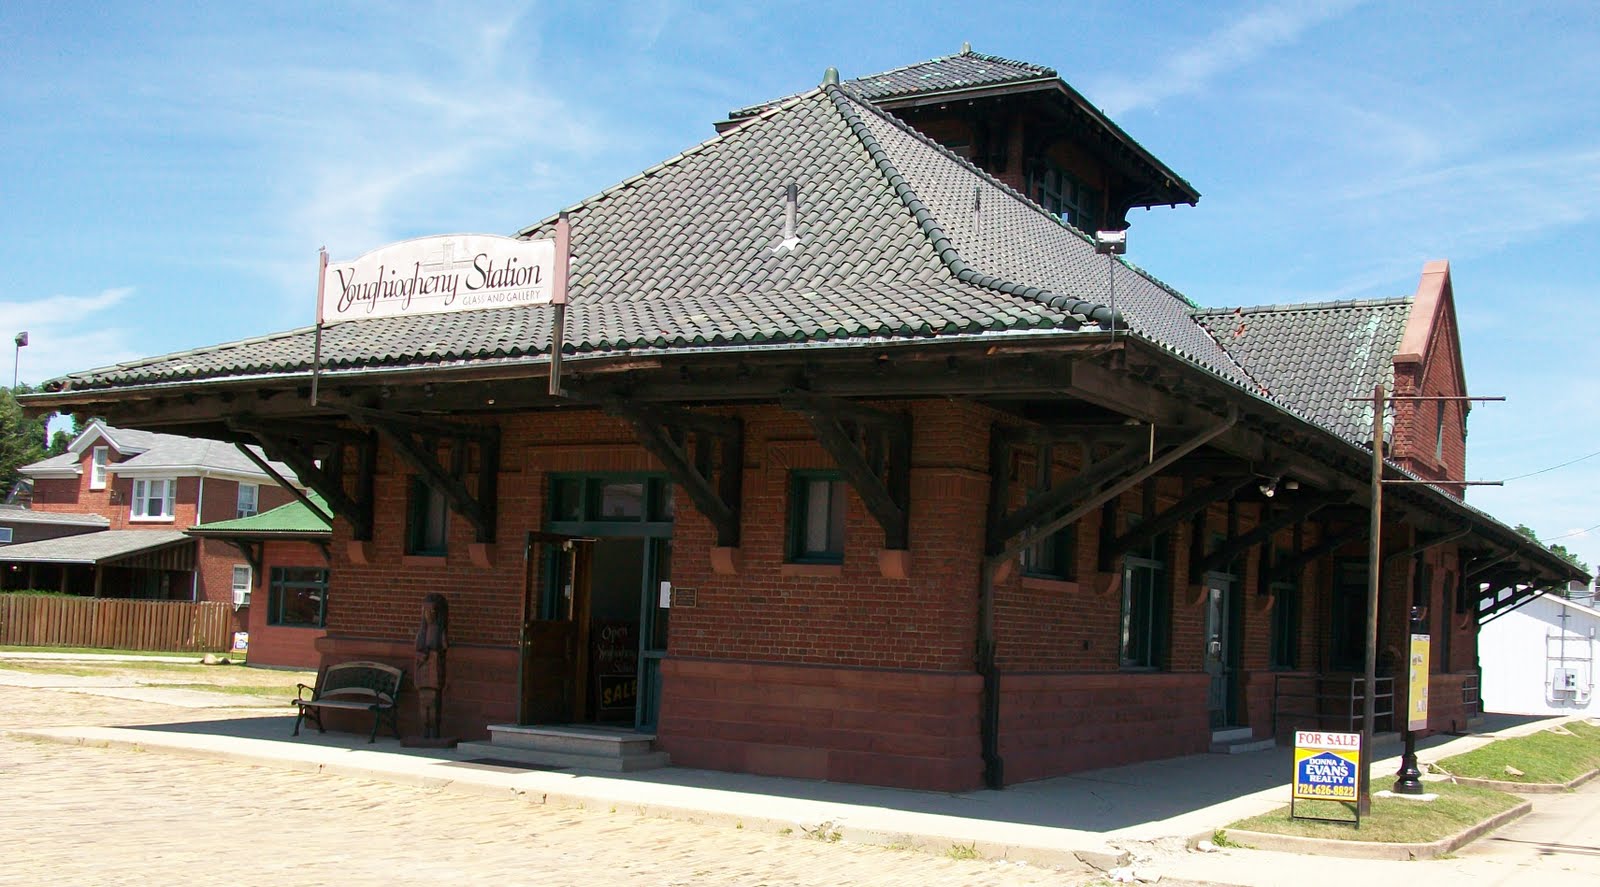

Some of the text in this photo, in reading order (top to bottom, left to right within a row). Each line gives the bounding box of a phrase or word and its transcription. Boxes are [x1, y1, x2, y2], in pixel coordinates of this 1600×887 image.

[333, 253, 542, 313] Youghiogheny Station
[463, 290, 541, 305] GLASS AND GALLERY
[1298, 733, 1358, 746] FOR SALE
[1309, 758, 1337, 766] DONNA
[1306, 764, 1348, 776] EVANS
[1309, 775, 1344, 783] REALTY
[1299, 784, 1354, 796] 724-626-8822
